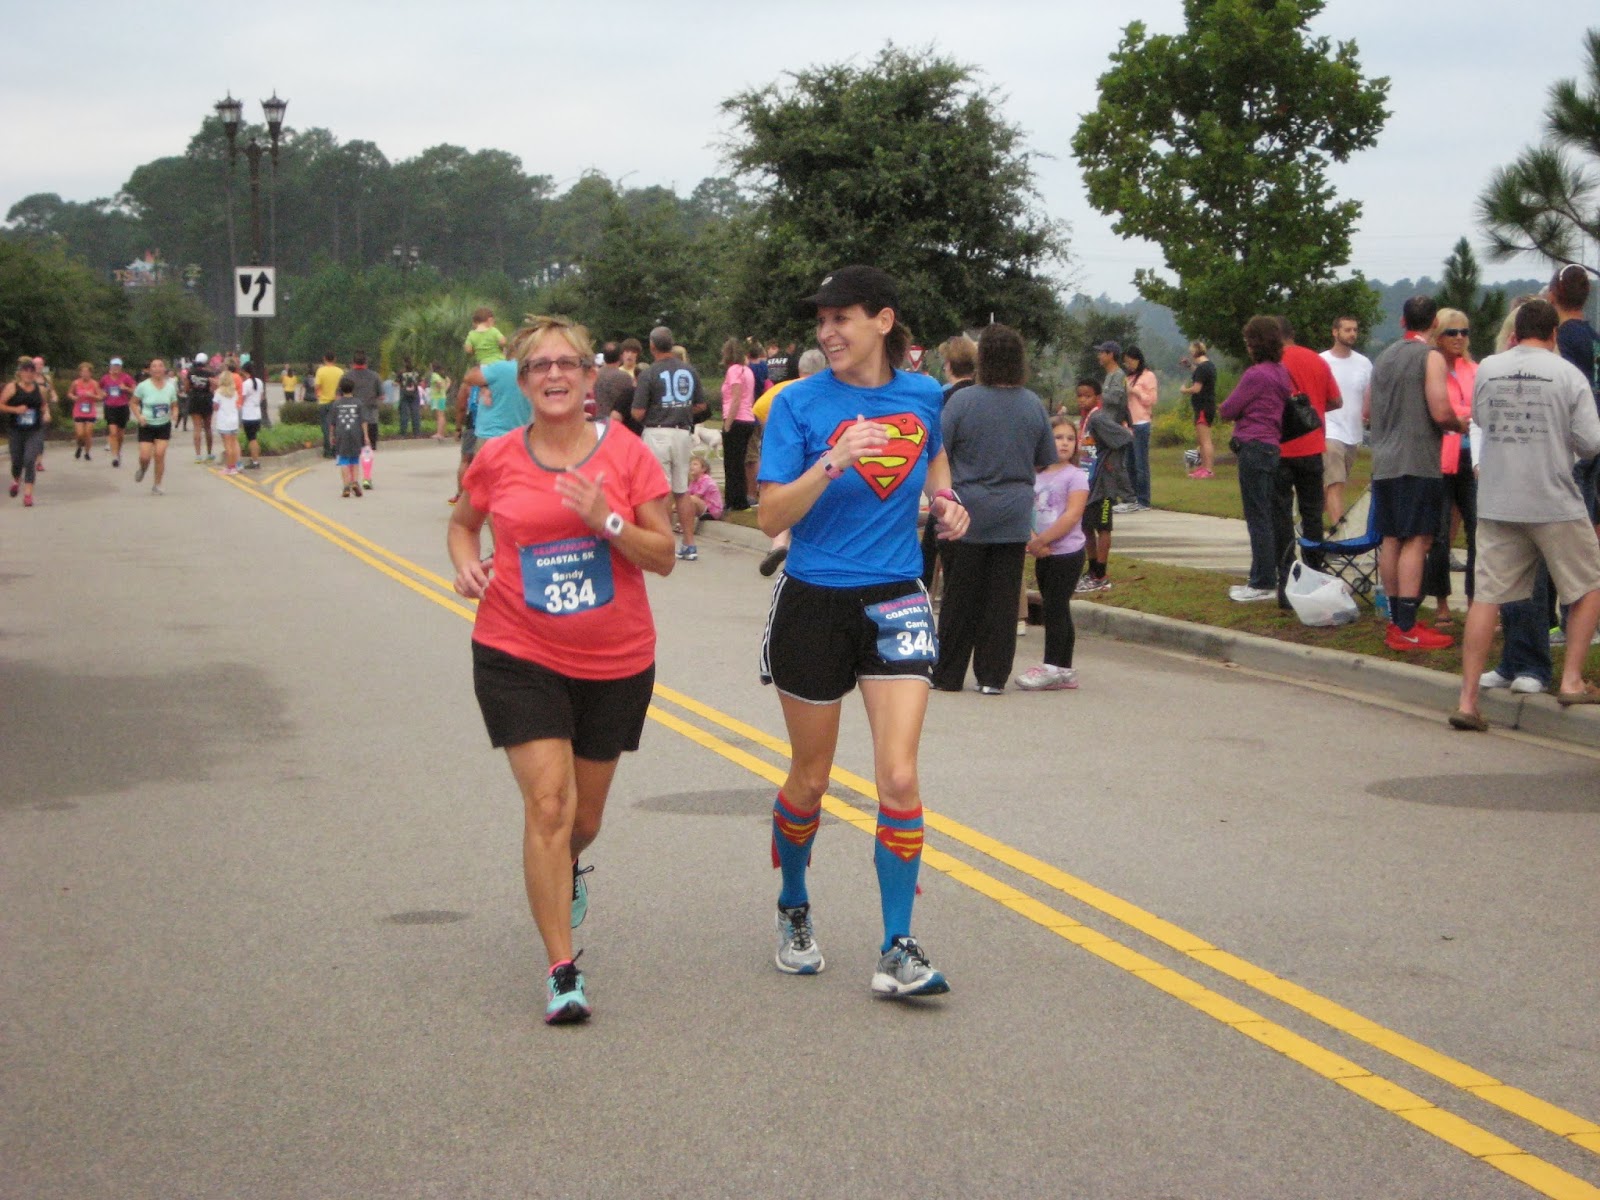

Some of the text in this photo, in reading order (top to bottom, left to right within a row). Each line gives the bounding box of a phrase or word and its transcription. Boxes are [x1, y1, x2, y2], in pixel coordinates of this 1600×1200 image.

[660, 369, 694, 402] 10
[536, 553, 580, 567] COASTAL
[544, 578, 596, 613] 334
[885, 606, 923, 619] COASTAL
